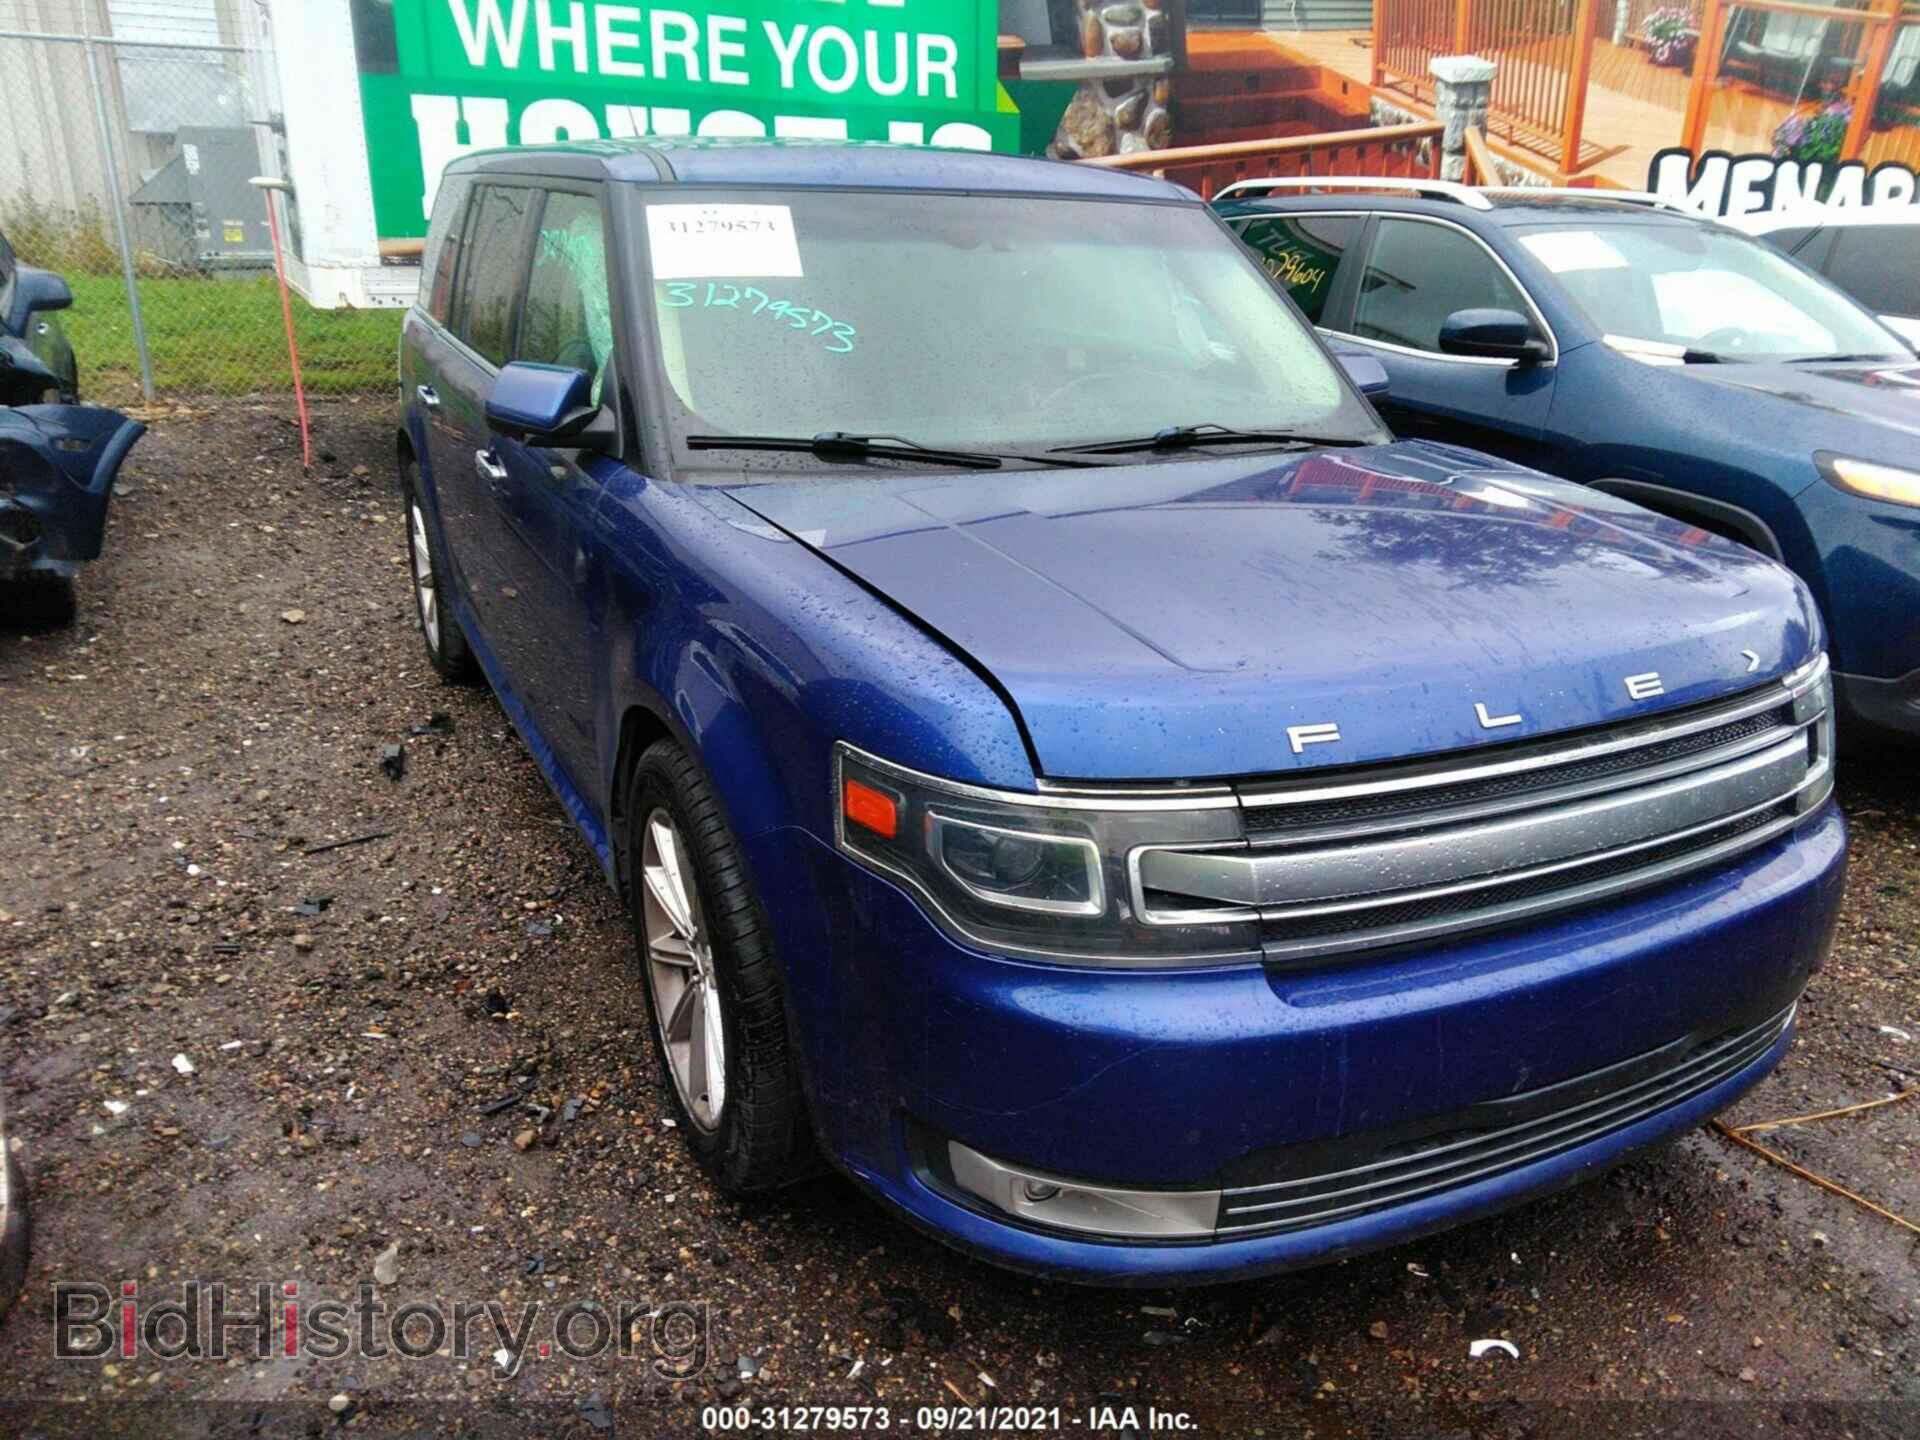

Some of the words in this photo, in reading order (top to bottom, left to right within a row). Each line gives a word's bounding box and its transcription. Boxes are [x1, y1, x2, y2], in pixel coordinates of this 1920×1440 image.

[447, 0, 750, 86] WHERE
[762, 20, 959, 98] YOUR
[656, 282, 856, 353] 31279573
